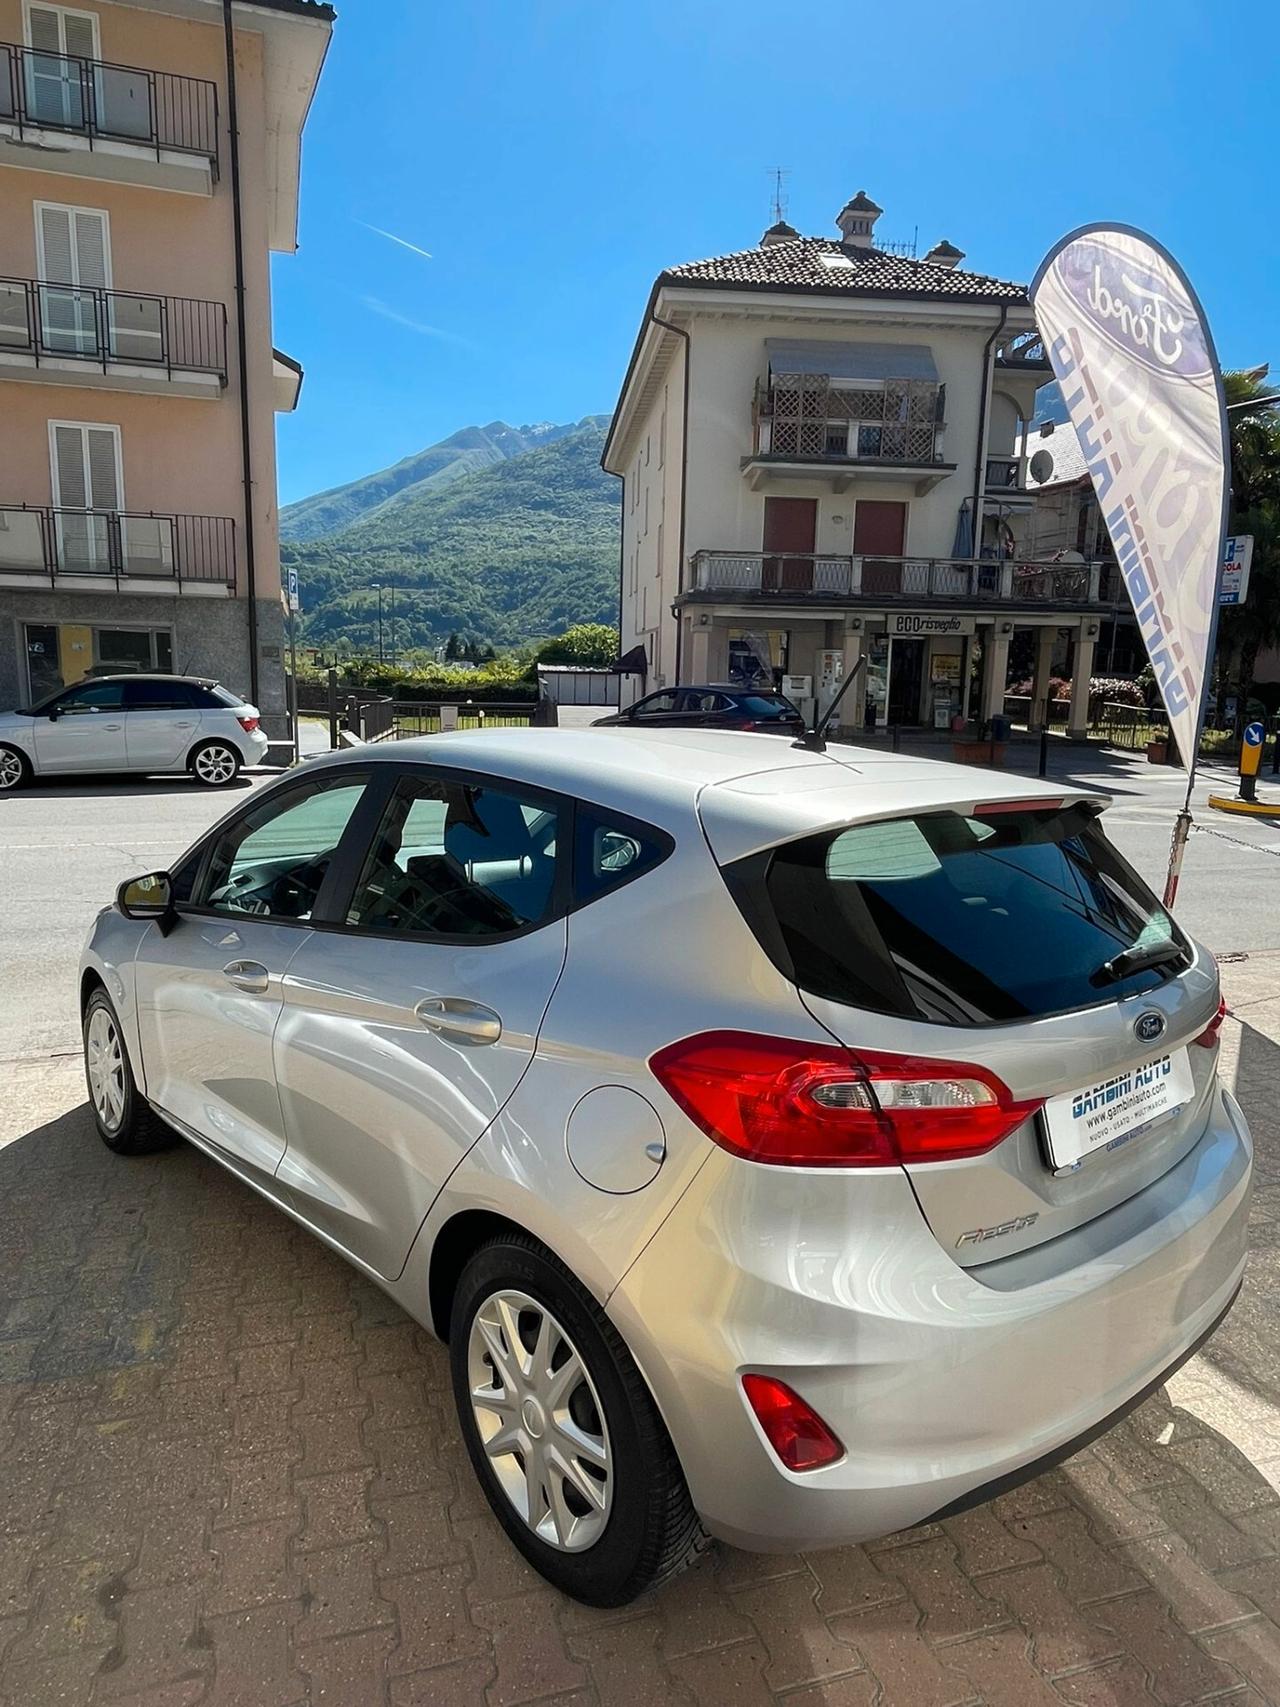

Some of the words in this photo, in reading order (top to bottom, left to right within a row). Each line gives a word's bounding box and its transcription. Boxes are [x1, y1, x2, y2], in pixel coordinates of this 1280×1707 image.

[290, 575, 296, 591] P
[1072, 1072, 1131, 1119] GAMBINI
[1135, 1055, 1171, 1089] AUTO
[1086, 1082, 1167, 1129] www.gambiniauto.com
[1089, 1127, 1109, 1143] NUOVO
[1112, 1116, 1130, 1131] USATO
[1134, 1097, 1168, 1118] MULTIMARCHE
